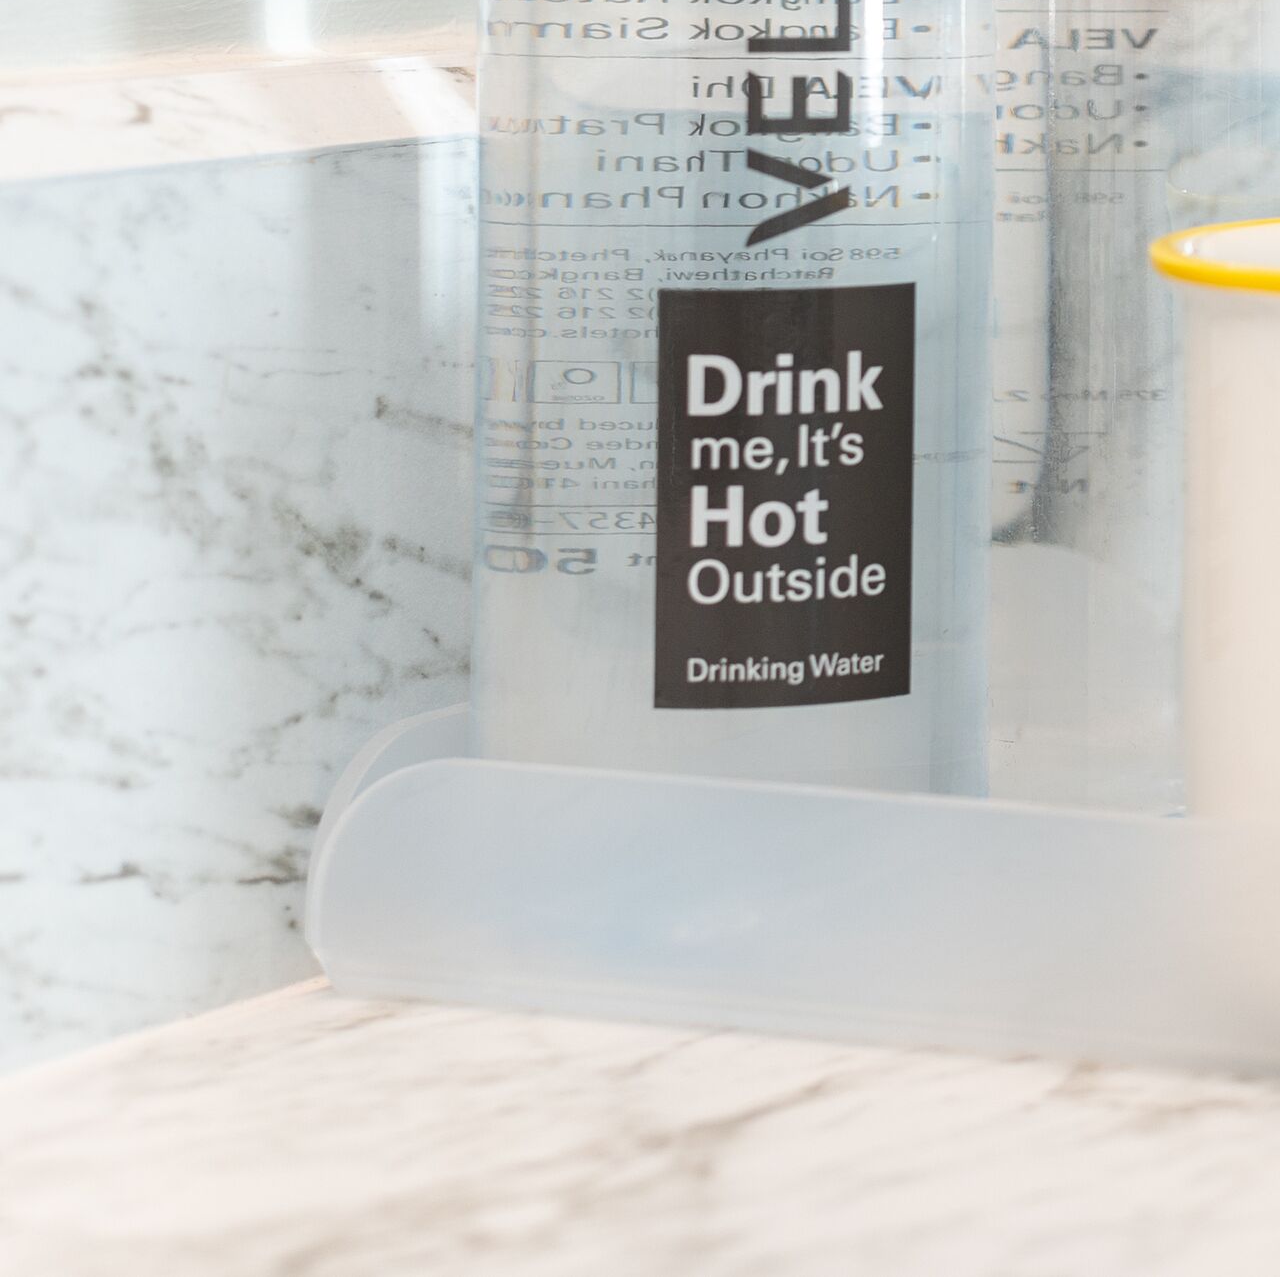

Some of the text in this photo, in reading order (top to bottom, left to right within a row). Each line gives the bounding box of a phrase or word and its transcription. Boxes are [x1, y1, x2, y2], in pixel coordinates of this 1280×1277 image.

[686, 350, 884, 417] Drink
[690, 435, 788, 477] me,
[689, 485, 829, 548] Hot
[687, 554, 887, 605] Outside
[686, 649, 884, 686] Drinking Water
